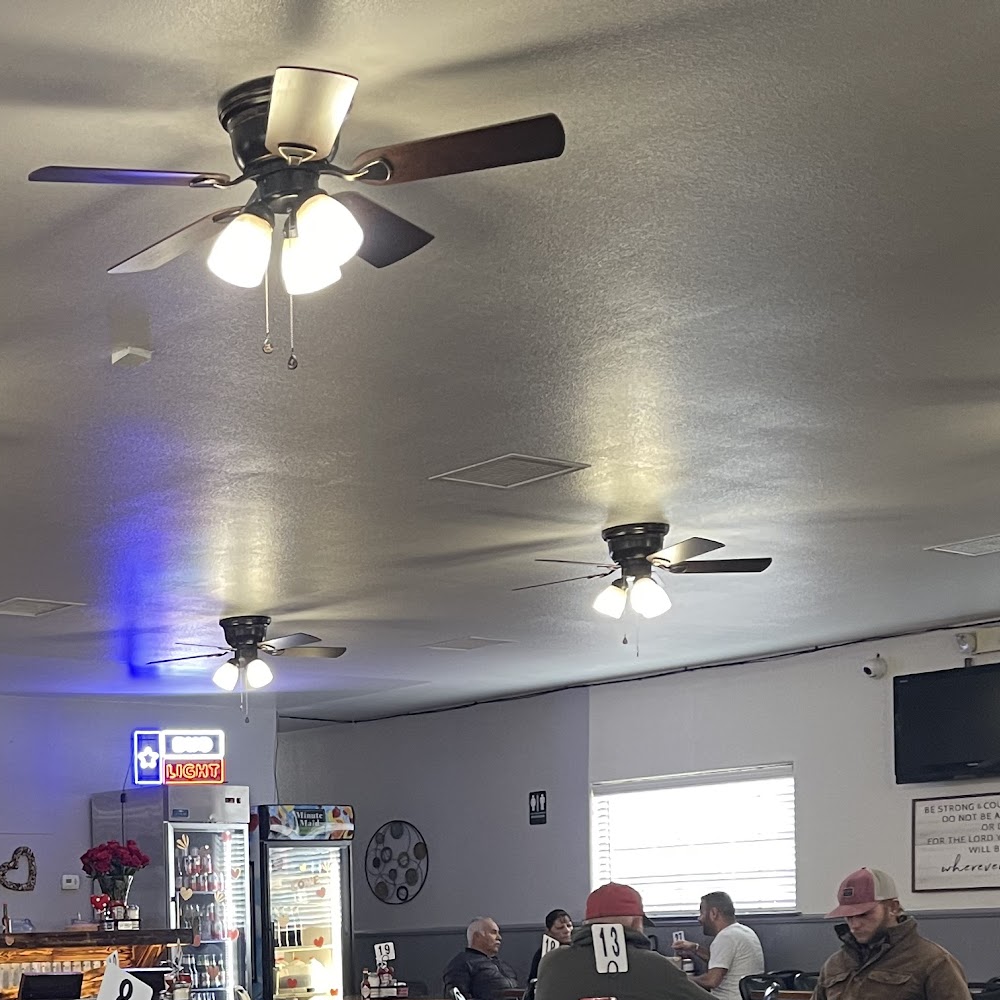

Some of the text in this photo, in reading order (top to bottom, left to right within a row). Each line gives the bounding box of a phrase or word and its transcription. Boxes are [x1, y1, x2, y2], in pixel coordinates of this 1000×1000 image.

[166, 763, 220, 779] LIGHT
[924, 806, 935, 814] BE
[937, 803, 975, 812] STRONG
[296, 811, 323, 819] Minute
[958, 813, 977, 821] NOT
[980, 812, 992, 820] BE
[300, 819, 320, 827] Maid
[981, 823, 995, 831] OR
[927, 837, 945, 845] FOR
[948, 836, 966, 844] THE
[968, 834, 994, 843] LORD
[941, 853, 1000, 872] whereve
[600, 926, 620, 957] 13
[378, 944, 390, 955] 19
